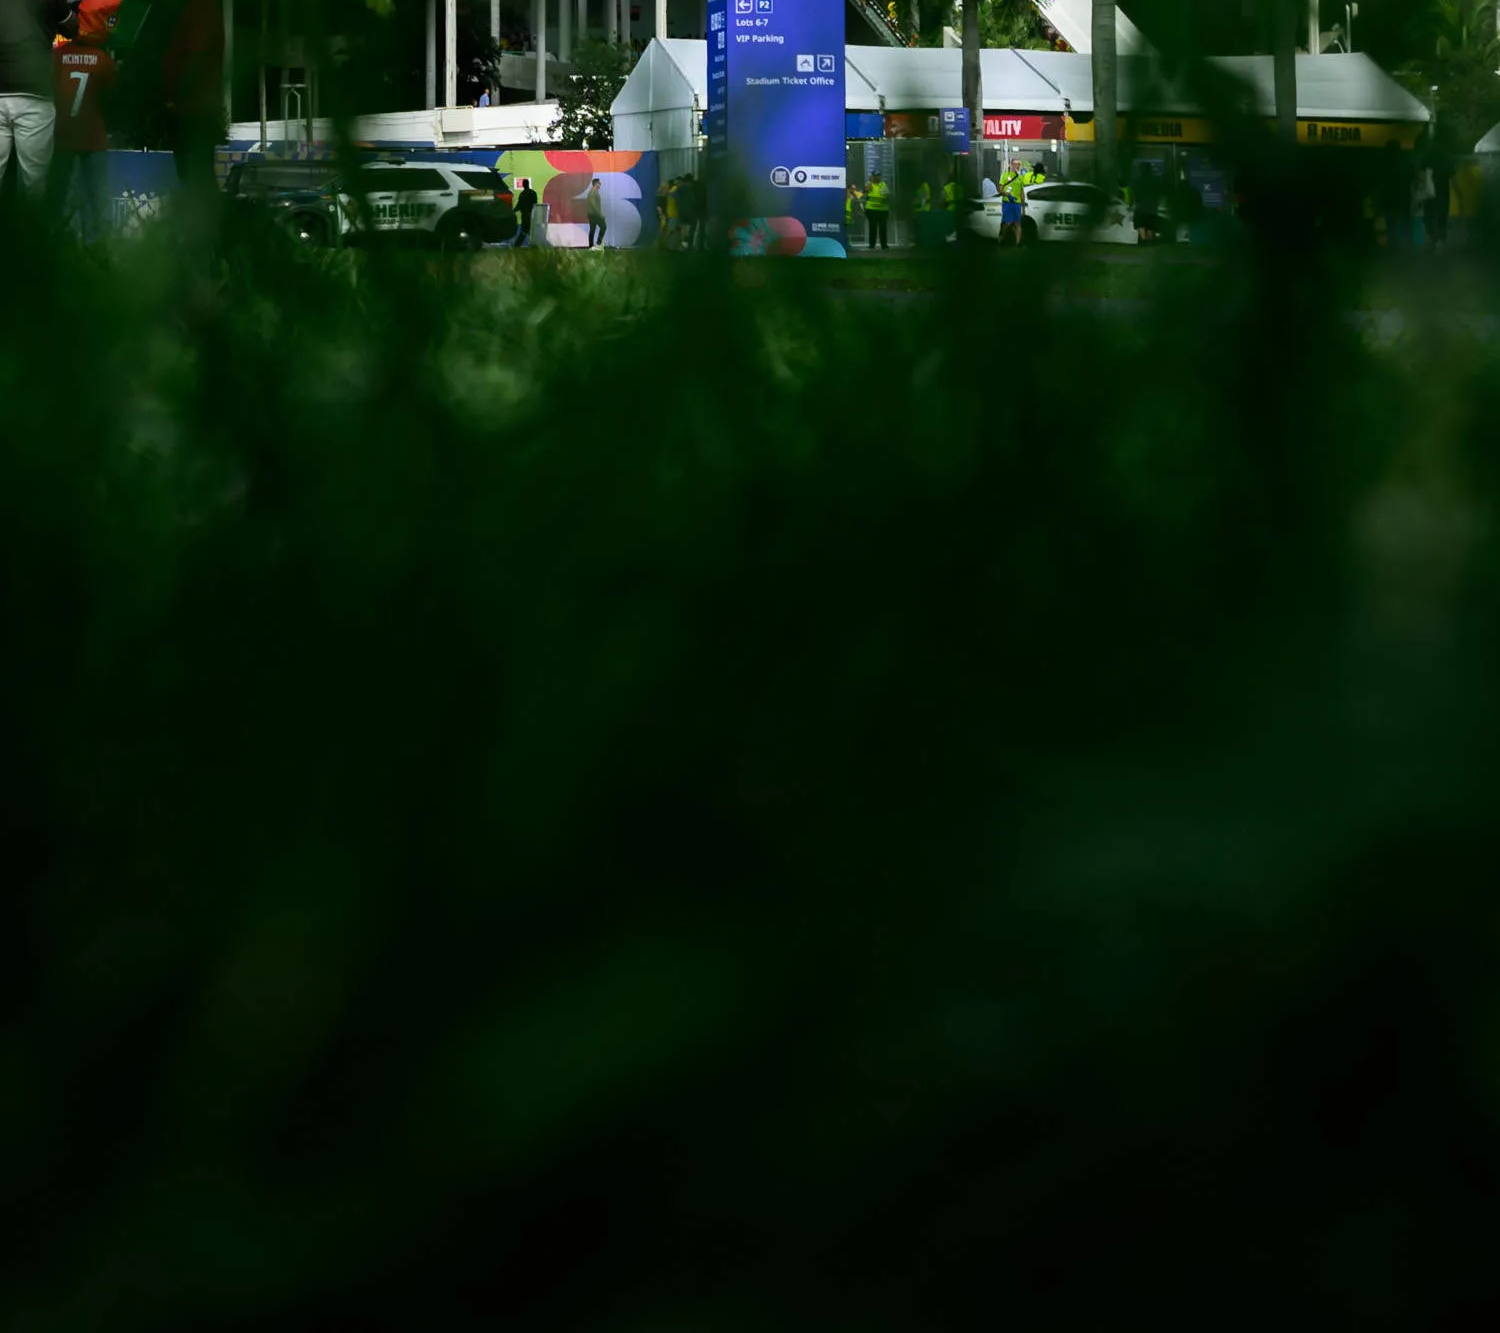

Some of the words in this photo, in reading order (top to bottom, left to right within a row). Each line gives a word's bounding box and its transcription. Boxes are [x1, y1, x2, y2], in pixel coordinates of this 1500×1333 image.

[760, 0, 770, 9] P2
[736, 19, 753, 27] Lots
[755, 18, 769, 27] 6-7
[736, 35, 750, 43] VIP
[752, 35, 784, 44] Parking
[746, 77, 780, 85] Stadium
[782, 77, 808, 85] Ticket
[810, 77, 834, 85] Office
[70, 71, 90, 117] 7
[1321, 126, 1361, 142] MEDIA
[372, 203, 437, 218] HERIFF
